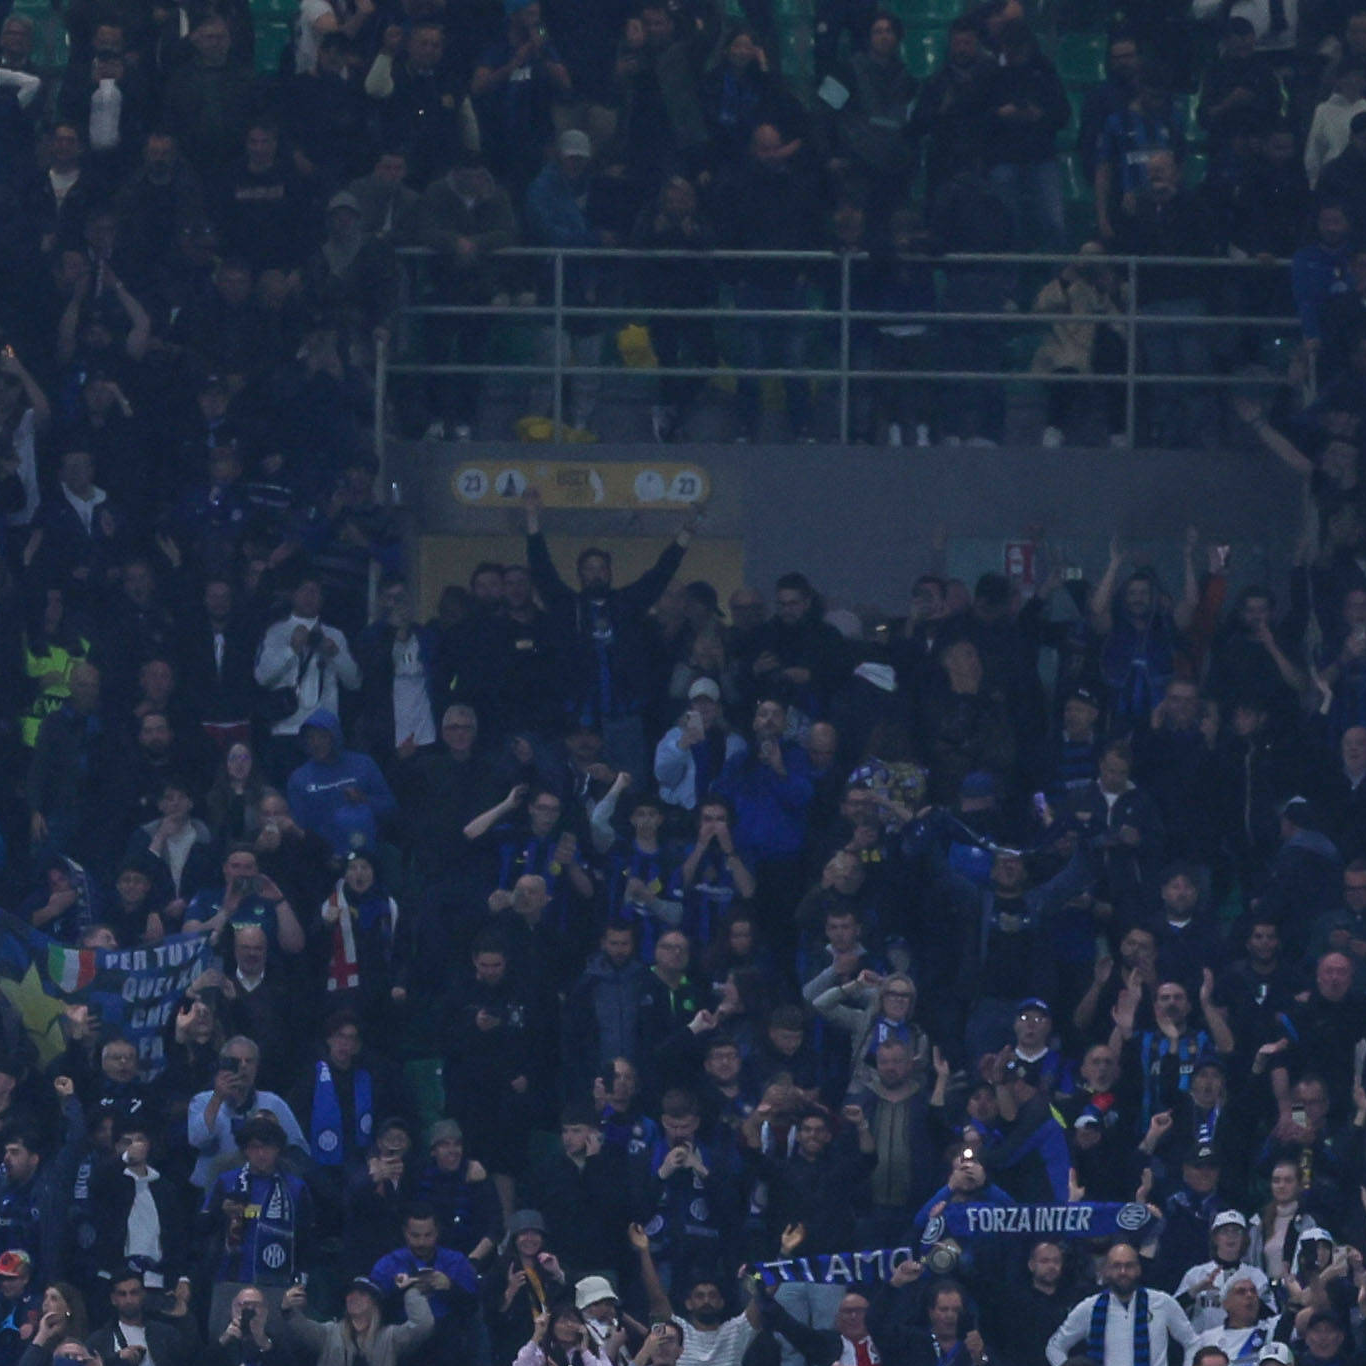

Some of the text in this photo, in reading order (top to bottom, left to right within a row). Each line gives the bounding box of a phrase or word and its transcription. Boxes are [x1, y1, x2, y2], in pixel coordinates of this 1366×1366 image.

[966, 1205, 1092, 1232] FORZA INTER
[825, 1246, 914, 1282] AMO
